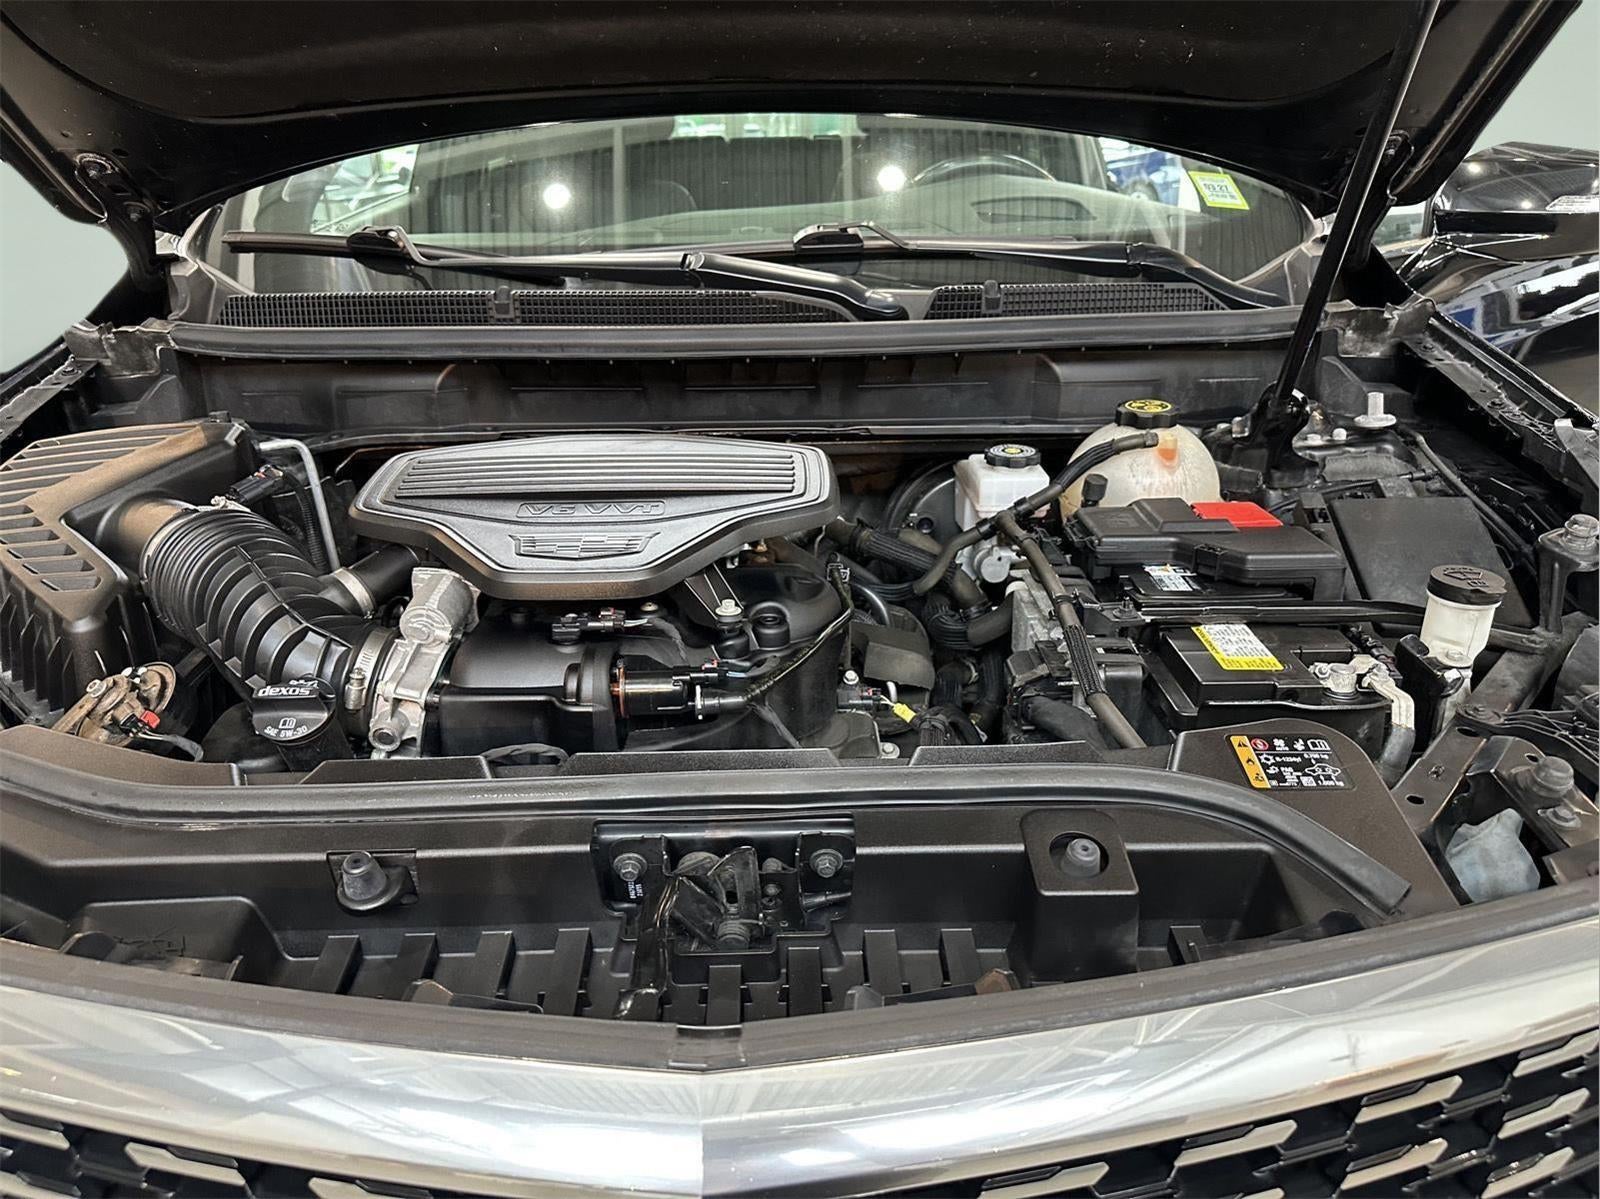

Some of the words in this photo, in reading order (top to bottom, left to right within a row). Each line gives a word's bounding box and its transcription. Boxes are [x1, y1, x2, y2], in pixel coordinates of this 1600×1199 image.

[525, 503, 575, 516] V6
[584, 502, 660, 515] VVT
[258, 685, 310, 697] dexos
[264, 725, 279, 737] SAE
[280, 725, 308, 738] 5W-30
